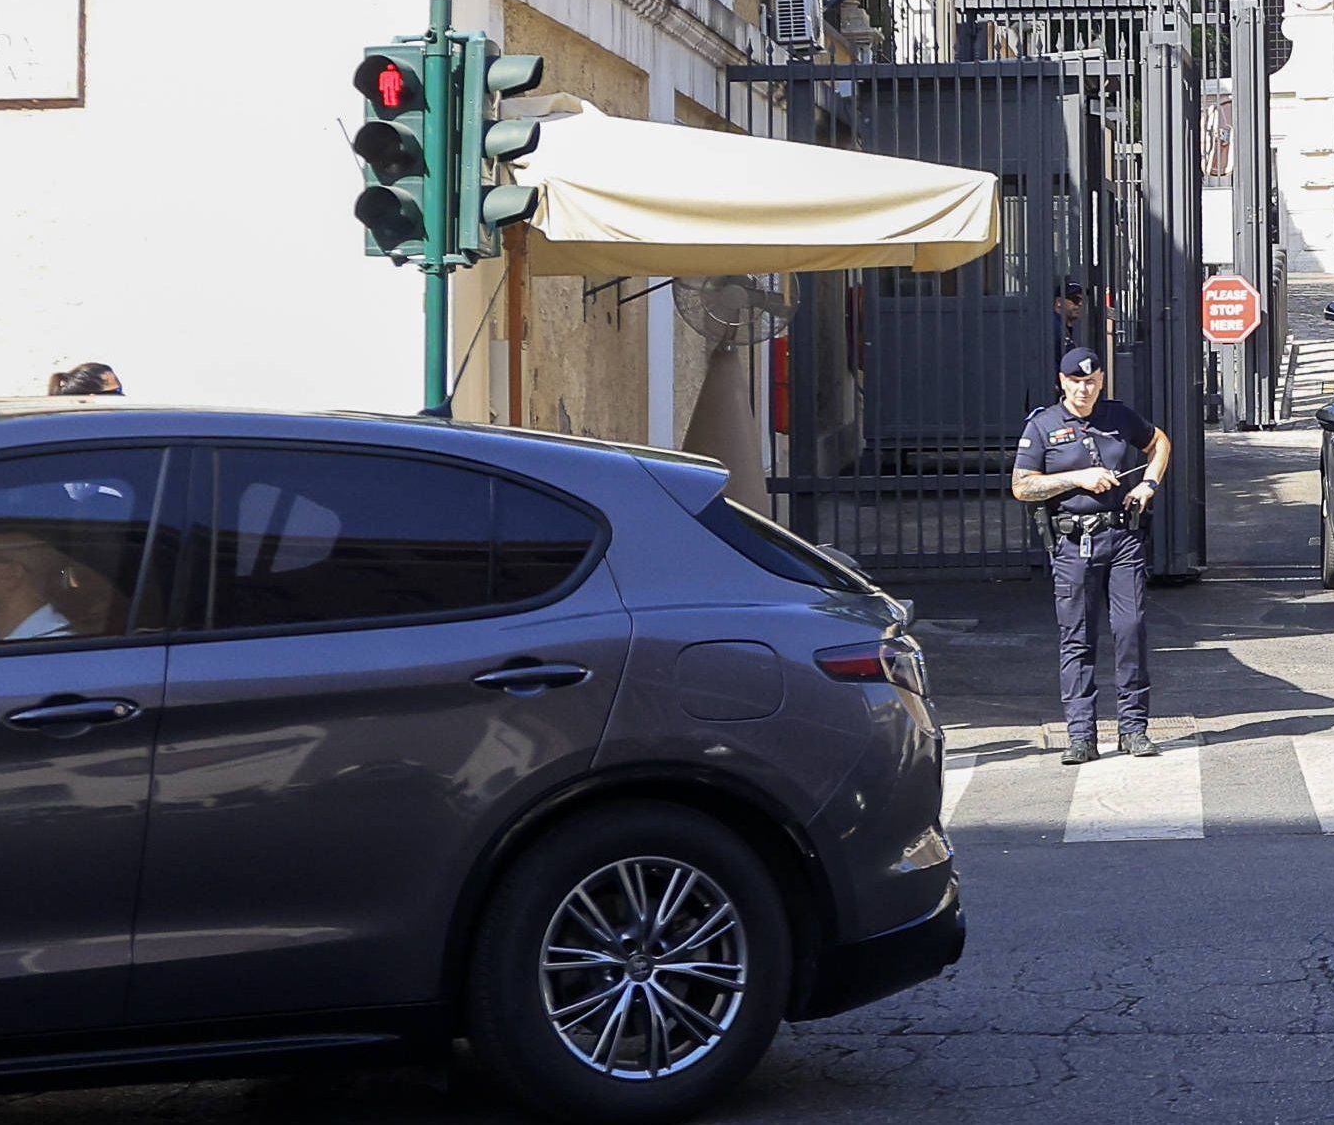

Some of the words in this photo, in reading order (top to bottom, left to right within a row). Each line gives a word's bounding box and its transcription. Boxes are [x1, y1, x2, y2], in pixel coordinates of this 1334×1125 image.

[1205, 289, 1247, 301] PLEASE
[1209, 304, 1244, 316] STOP
[1210, 319, 1244, 331] HERE
